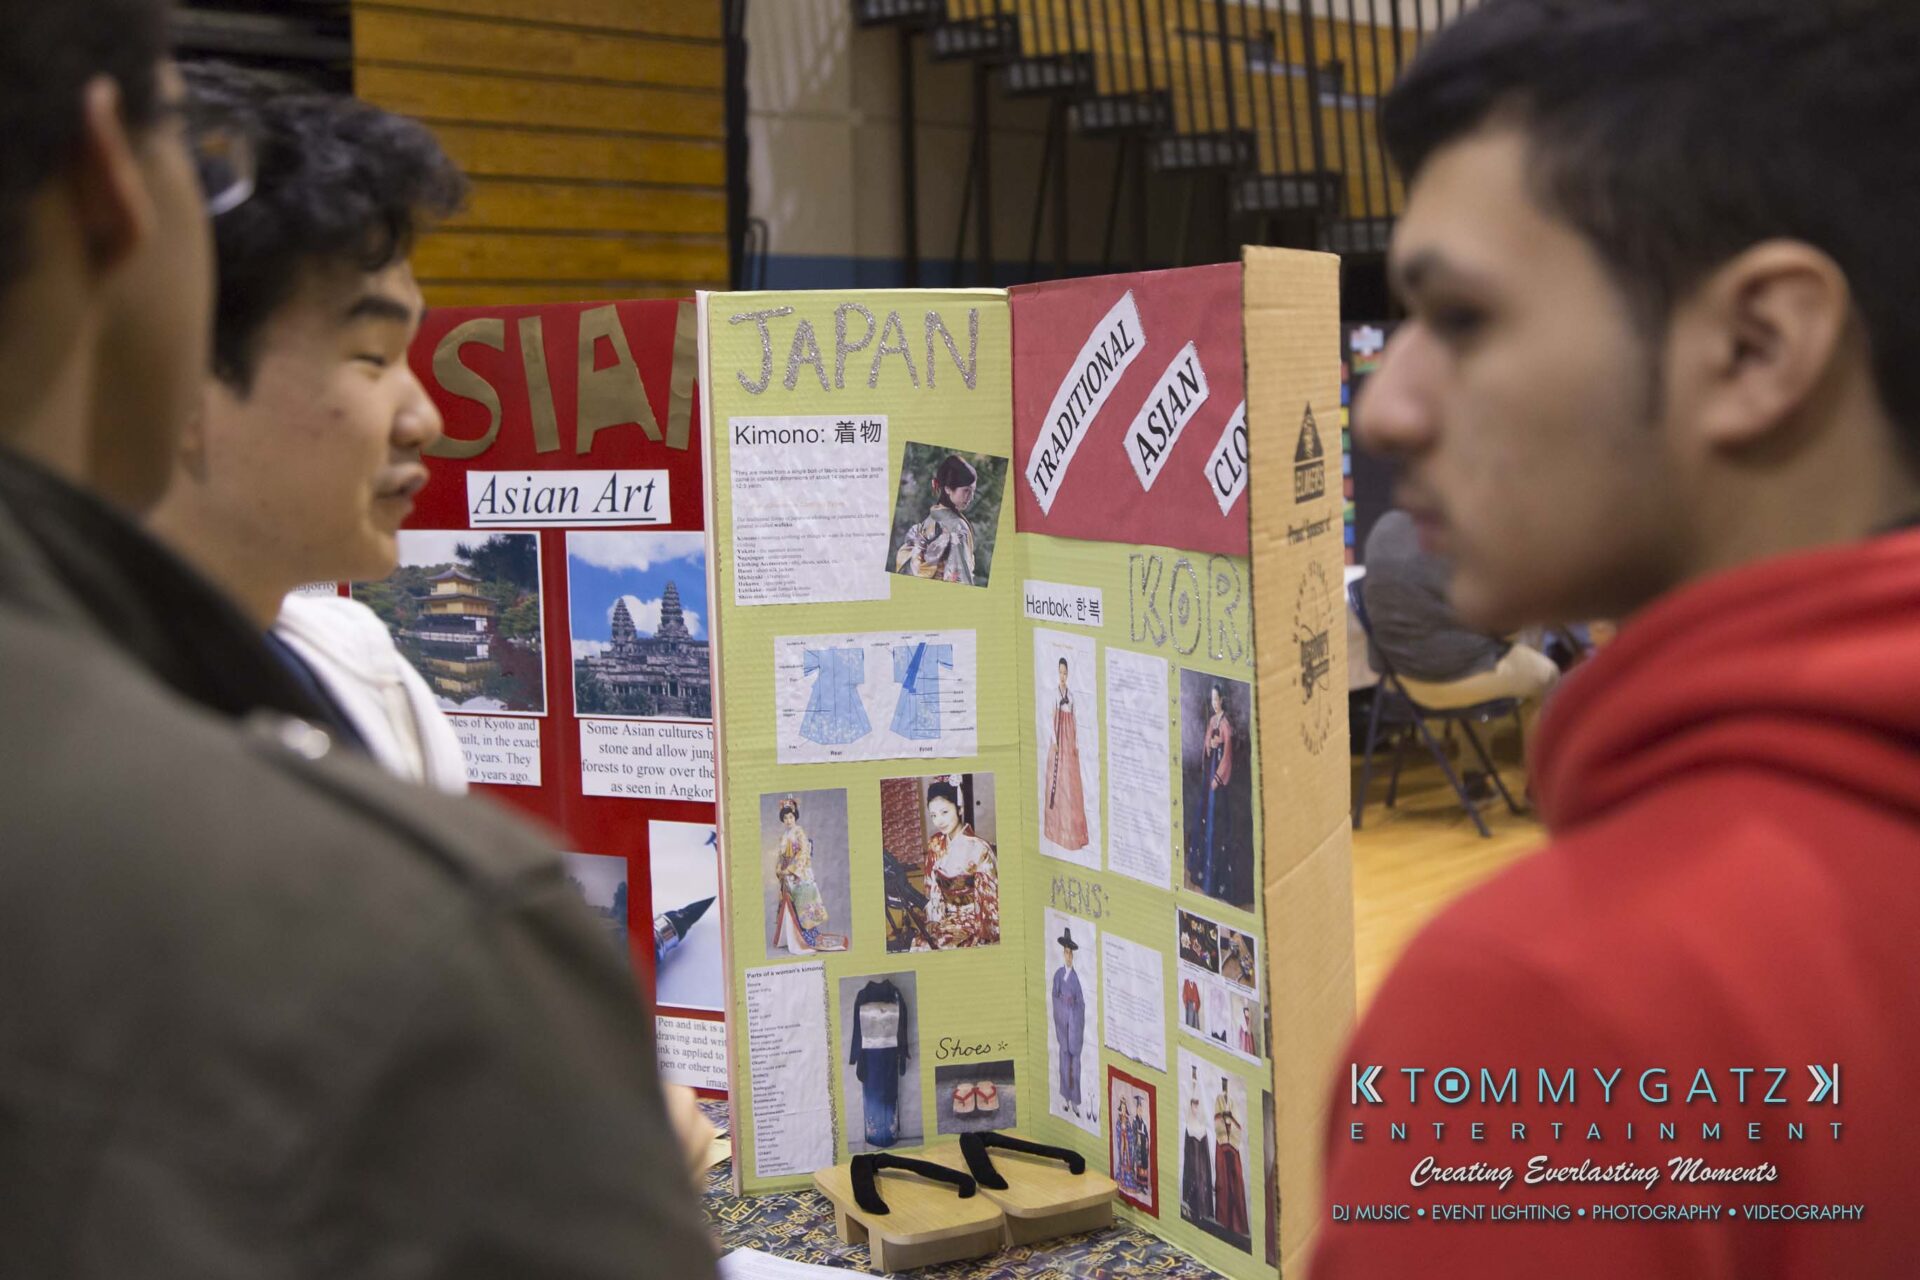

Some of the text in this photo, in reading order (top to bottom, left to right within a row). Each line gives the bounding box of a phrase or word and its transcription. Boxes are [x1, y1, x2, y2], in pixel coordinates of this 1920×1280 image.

[728, 303, 979, 394] JAPAN
[418, 300, 699, 459] SIA
[1033, 319, 1135, 496] TRADITIONAL
[1135, 357, 1201, 476] ASIAN
[735, 425, 825, 445] Kimono:
[834, 420, 882, 444] 着物
[1214, 415, 1248, 497] CLO
[473, 472, 656, 515] Asian Art
[1026, 594, 1072, 619] Hanbok:
[1076, 597, 1100, 623] 한복
[470, 717, 482, 728] of
[484, 717, 515, 732] Kyoto
[518, 720, 536, 731] and
[586, 721, 618, 735] Some
[622, 723, 655, 737] Asian
[658, 725, 704, 739] cultures
[458, 733, 540, 748] uilt, in the exact
[599, 743, 629, 755] stone
[631, 743, 653, 756] and
[656, 744, 688, 757] allow
[506, 752, 531, 767] They
[581, 759, 619, 773] forests
[622, 763, 633, 774] to
[636, 766, 665, 778] grow
[669, 767, 695, 778] over
[610, 782, 714, 801] as seen in Angkor
[658, 1017, 674, 1028] Pen
[676, 1020, 692, 1030] and
[694, 1022, 707, 1031] ink
[709, 1022, 718, 1033] is
[692, 1036, 708, 1046] and
[710, 1038, 726, 1047] wri
[935, 1037, 992, 1060] Shoes
[682, 1048, 714, 1060] applied
[677, 1062, 686, 1070] or
[688, 1061, 711, 1073] other
[712, 1065, 727, 1075] too
[706, 1078, 728, 1089] imag
